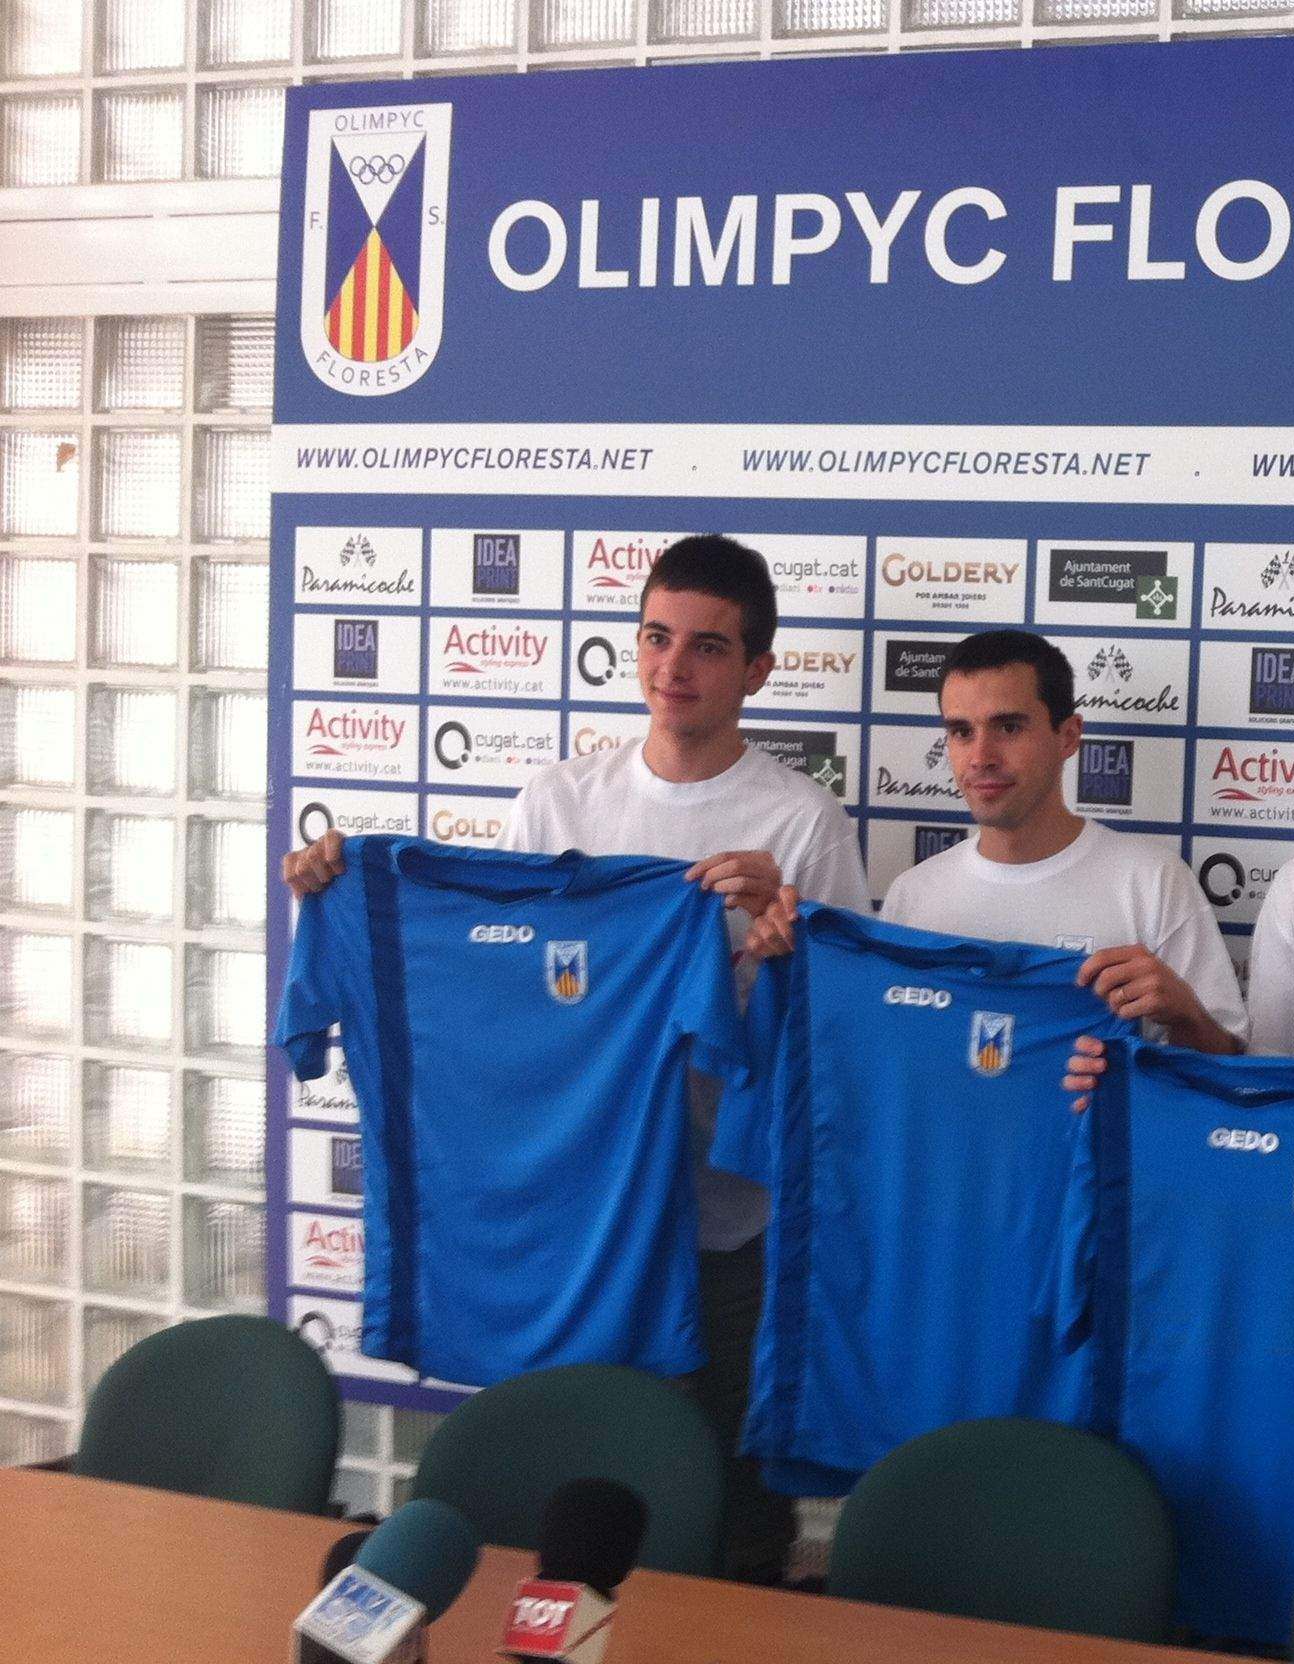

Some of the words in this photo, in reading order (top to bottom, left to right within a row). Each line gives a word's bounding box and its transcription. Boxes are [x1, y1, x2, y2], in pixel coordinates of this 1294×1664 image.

[334, 110, 425, 131] OLIMPYC
[428, 205, 445, 226] S.
[488, 186, 1008, 293] OLIMPYC
[316, 347, 429, 387] FLORESTA
[297, 447, 654, 471] WWW.OLIMPYCFLORESTA.NET
[742, 449, 1152, 476] WWW.OLIMPYCFLORESTA.NET
[476, 538, 517, 567] IDEA
[587, 538, 668, 571] Activ
[302, 565, 415, 594] Paramicoche
[773, 558, 859, 581] cugat.cat
[882, 552, 1020, 587] GOLDERY
[1064, 560, 1131, 574] Ajuntament
[1060, 575, 1075, 587] de
[1077, 575, 1135, 591] SantCugat
[337, 623, 376, 651] IDEA
[443, 624, 549, 665] Activity
[775, 651, 857, 674] DERY
[895, 665, 910, 678] de
[443, 677, 544, 694] www.activity.cat
[1074, 684, 1180, 712] amicoche
[306, 707, 406, 749] Activity
[475, 731, 553, 752] cugat.cat
[306, 760, 402, 776] www.activity.cat
[1083, 744, 1130, 775] IDEA
[337, 811, 412, 833] cugat.cat
[432, 809, 502, 841] GOLD
[469, 924, 536, 944] GEDO
[884, 985, 952, 1009] GEDO
[1208, 1127, 1280, 1154] GEDO
